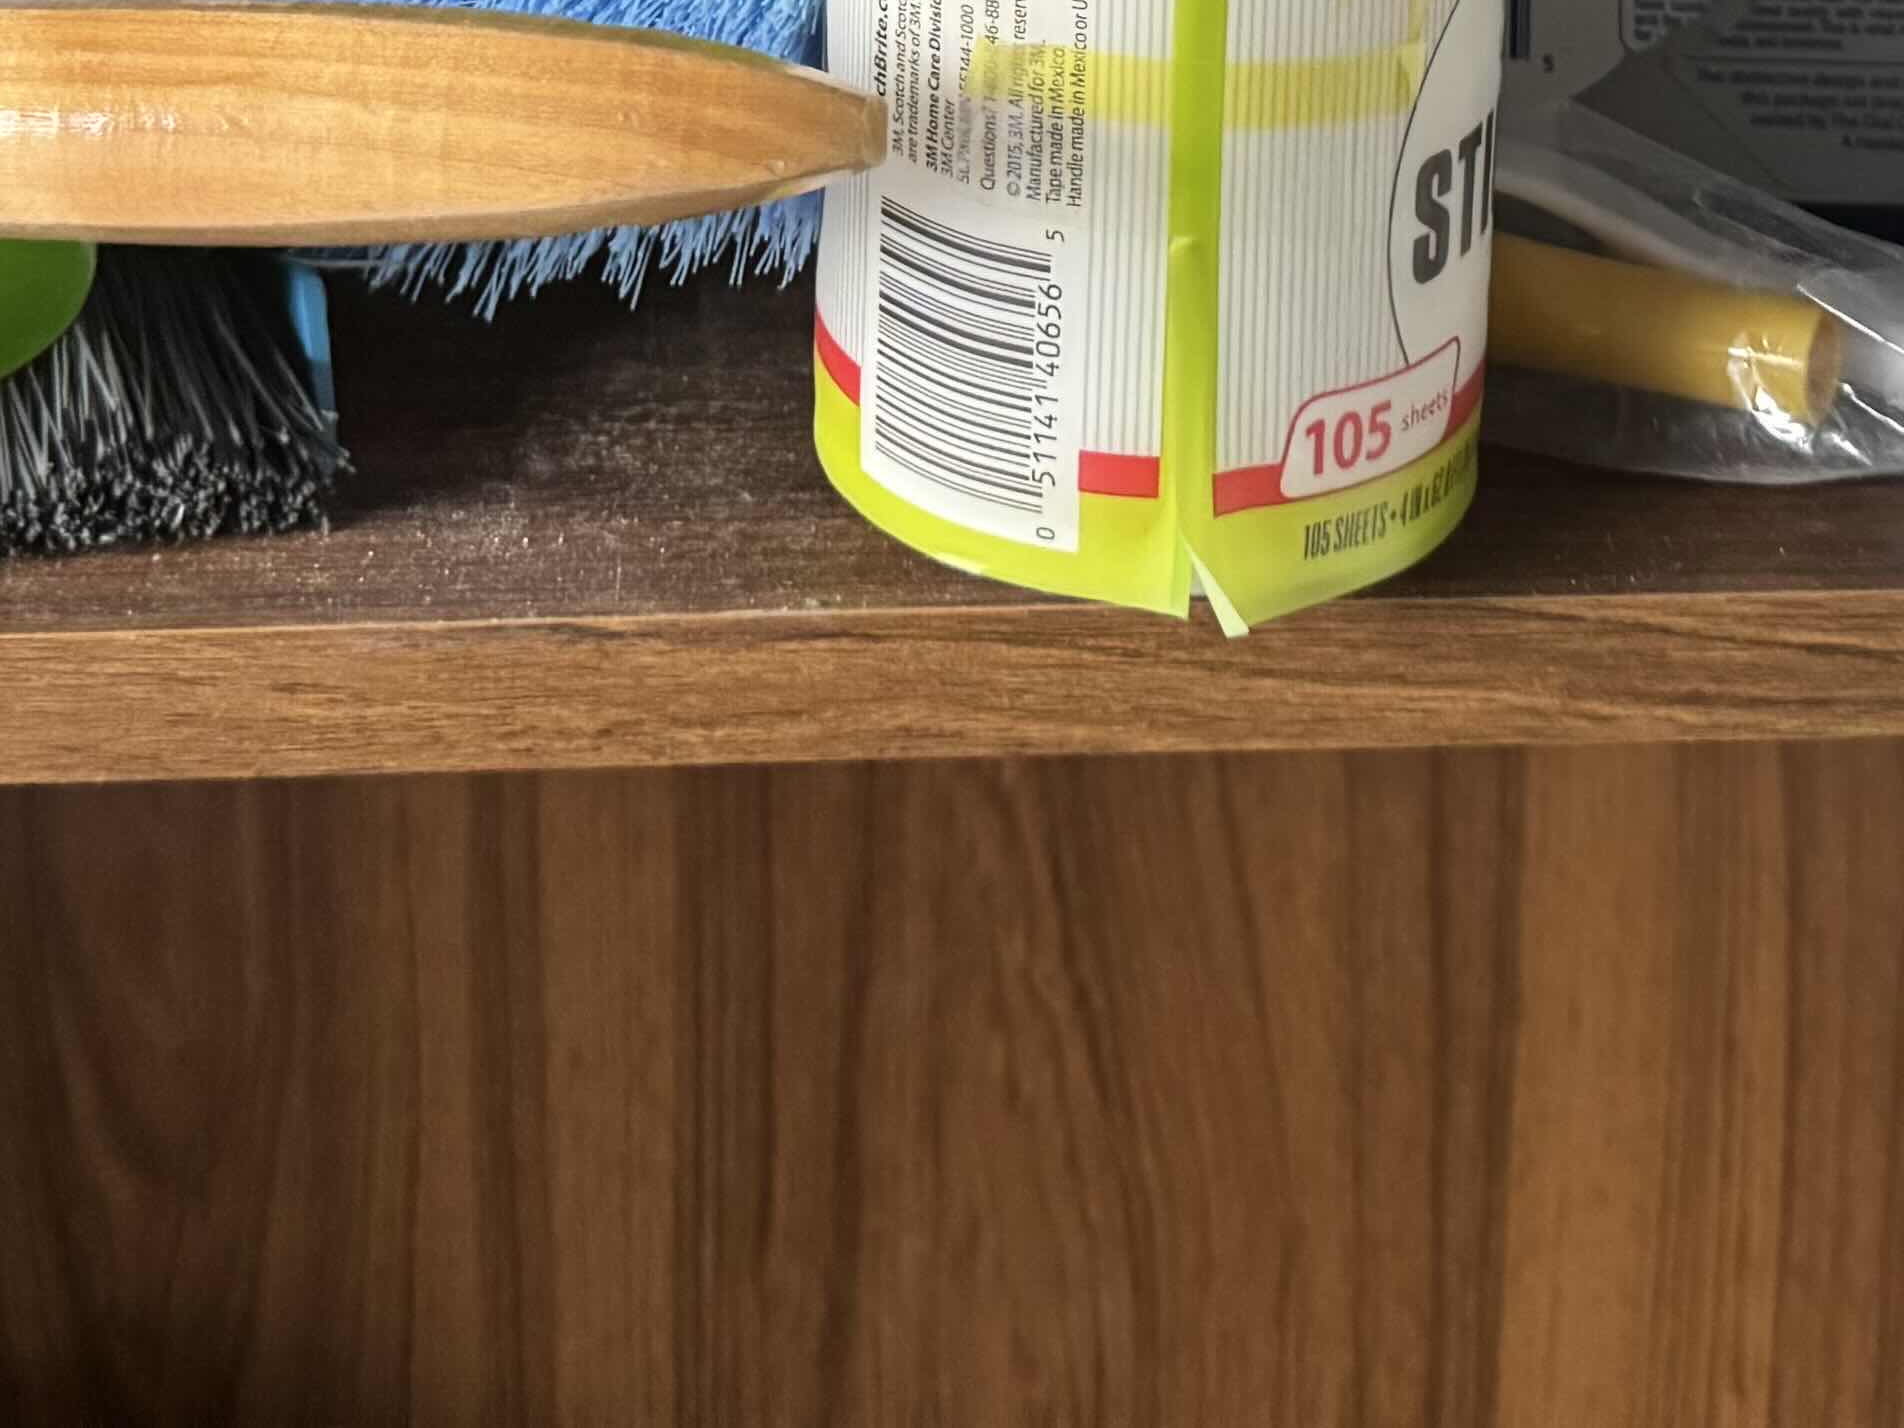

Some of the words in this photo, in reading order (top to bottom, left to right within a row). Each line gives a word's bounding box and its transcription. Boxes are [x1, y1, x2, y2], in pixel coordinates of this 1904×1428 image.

[908, 28, 920, 53] of
[1075, 14, 1087, 29] or
[896, 41, 905, 72] and
[928, 48, 940, 91] Care
[1069, 33, 1087, 88] Mexico
[893, 74, 904, 126] Scotch
[906, 53, 920, 140] trademarks
[1028, 71, 1045, 92] for
[1072, 91, 1084, 104] in
[926, 94, 939, 143] Home
[941, 99, 954, 151] Center
[1048, 101, 1064, 119] in
[1068, 107, 1084, 151] made
[909, 137, 917, 163] are
[926, 144, 937, 172] 3M
[941, 152, 952, 176] 3M
[1026, 94, 1046, 201] Manufactured
[1047, 123, 1063, 165] made
[1046, 164, 1064, 203] Tape
[1066, 153, 1083, 206] Handle
[1046, 230, 1064, 242] 5
[1031, 285, 1062, 376] 40656
[1027, 395, 1058, 487] 51141
[1305, 399, 1392, 476] 105
[1399, 391, 1448, 431] sheets
[1036, 527, 1055, 540] 0
[1303, 519, 1331, 560] 105
